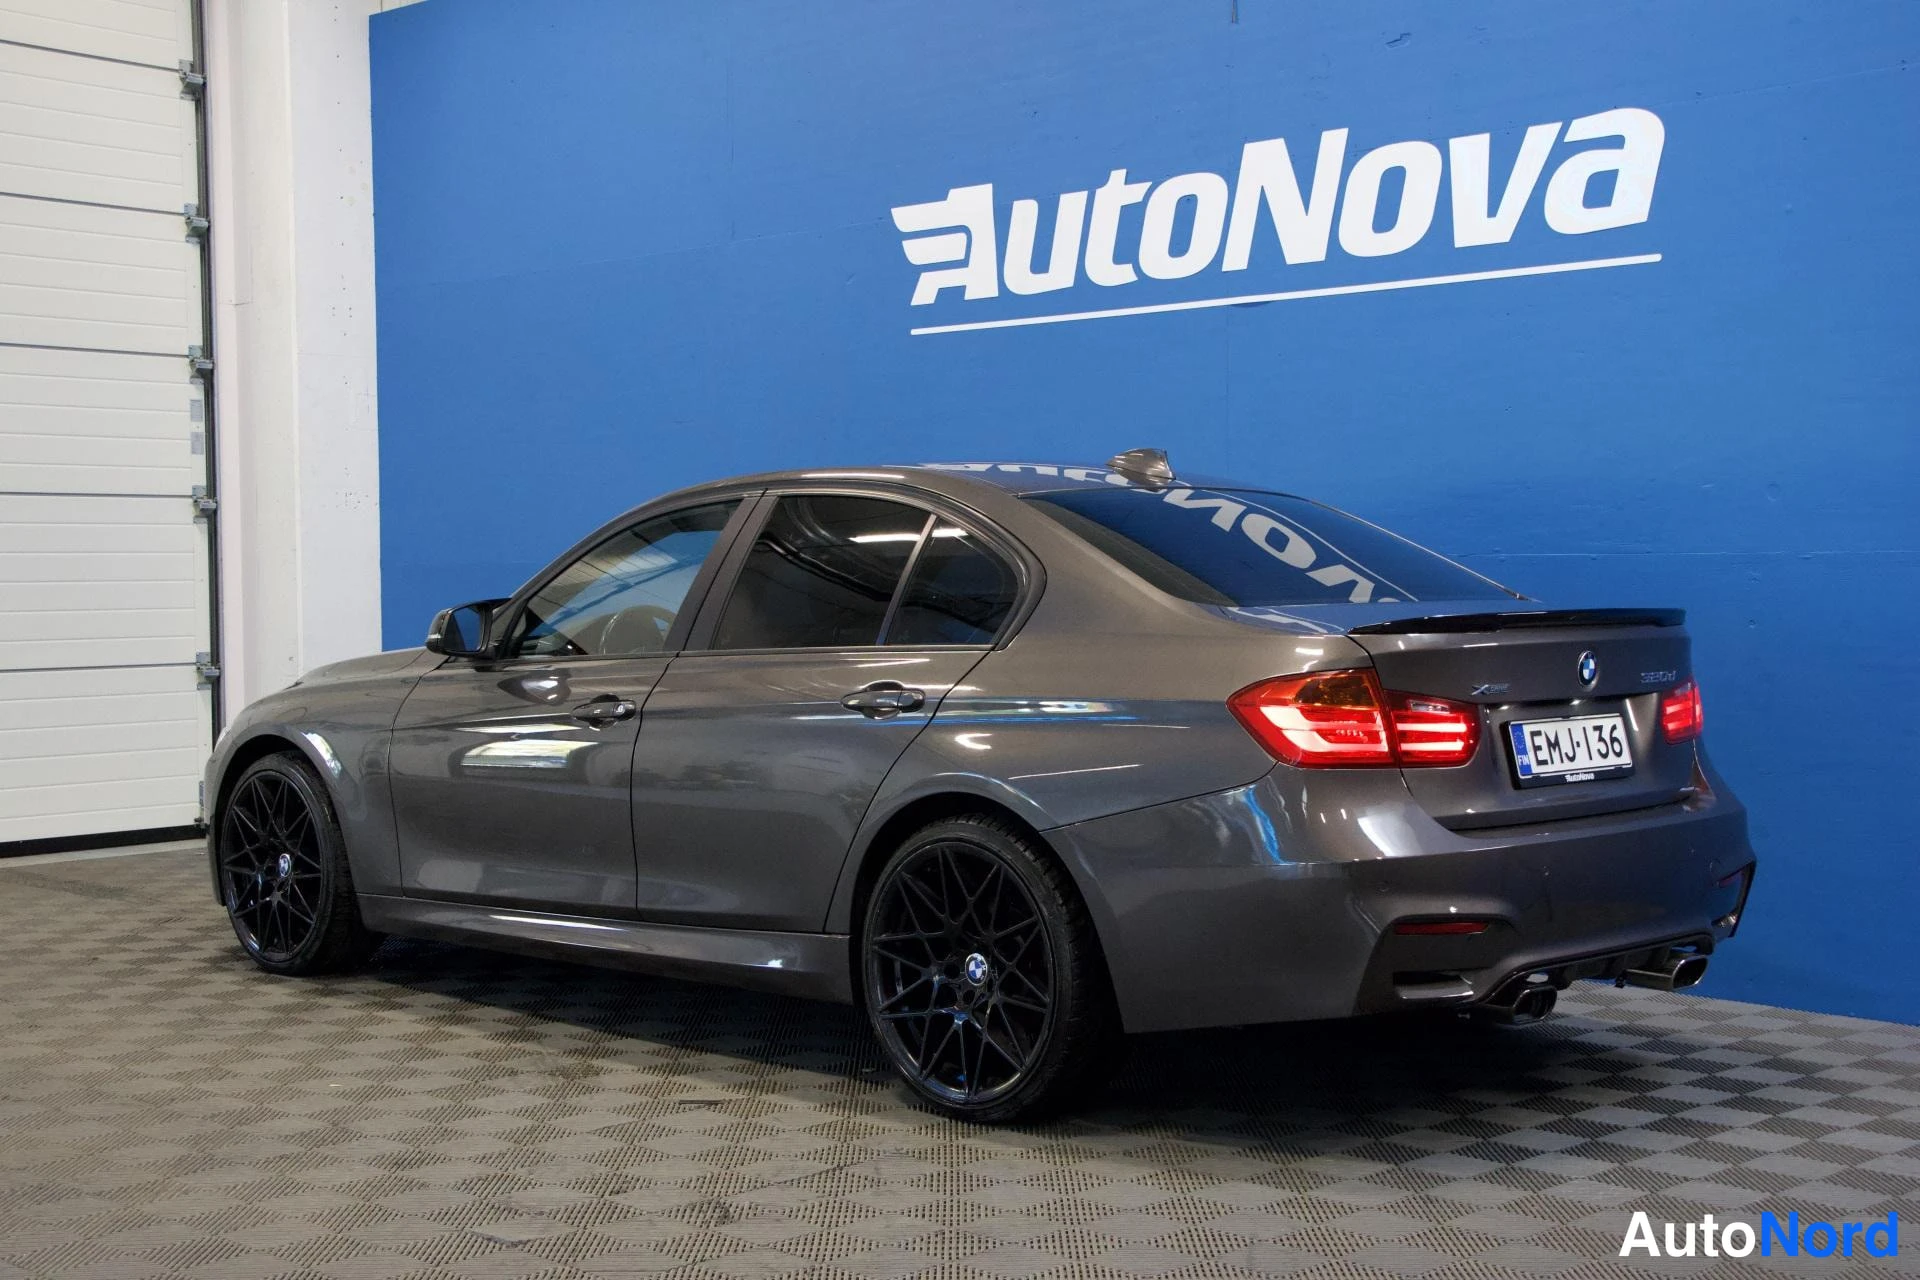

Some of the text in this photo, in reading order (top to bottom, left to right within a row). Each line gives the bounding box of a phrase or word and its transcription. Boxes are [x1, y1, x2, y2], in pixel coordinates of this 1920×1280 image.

[891, 107, 1665, 306] AutoNova
[1518, 755, 1530, 766] FIN
[1529, 723, 1624, 767] EMJ-136
